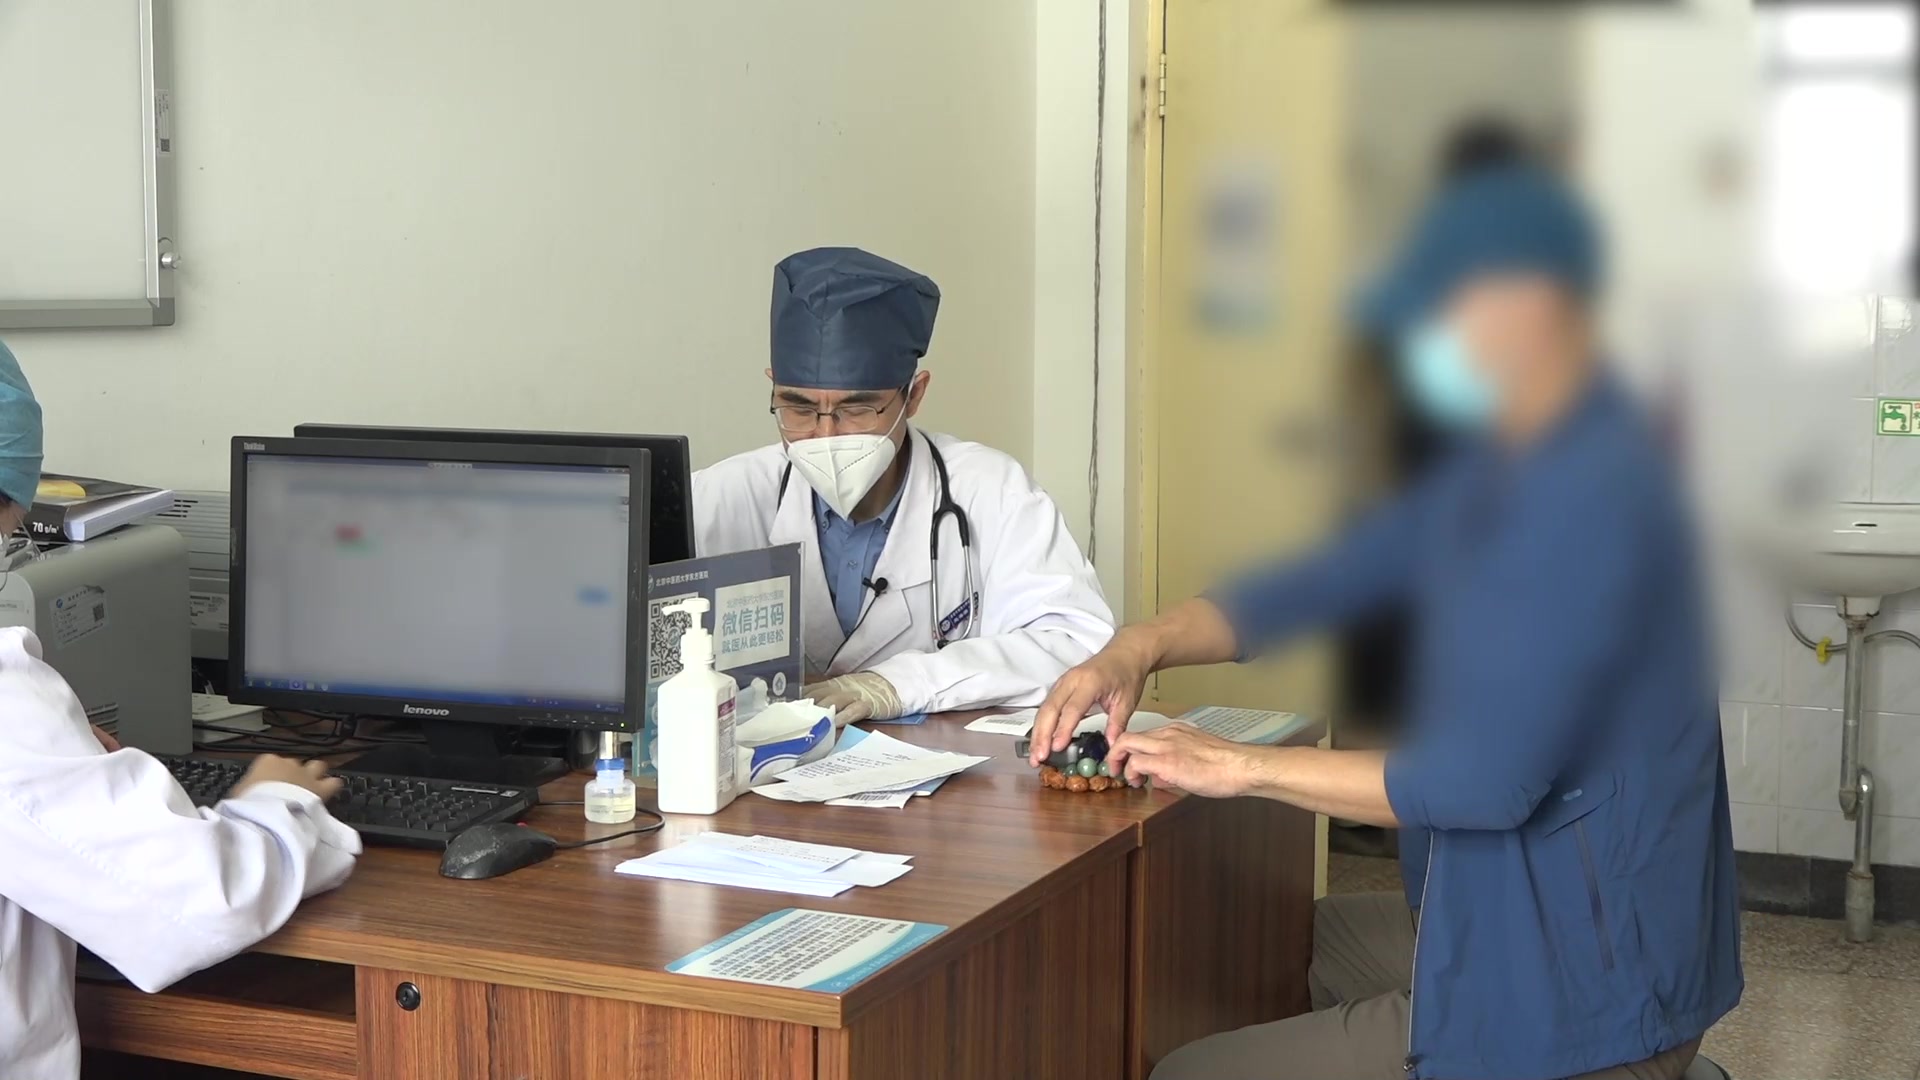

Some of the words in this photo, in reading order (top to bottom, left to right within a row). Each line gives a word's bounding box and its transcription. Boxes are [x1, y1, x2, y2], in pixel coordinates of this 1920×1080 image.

[32, 521, 43, 532] 70
[722, 602, 784, 637] 微信扫码
[721, 629, 784, 654] 就医从此更轻松
[403, 704, 450, 716] lenovo
